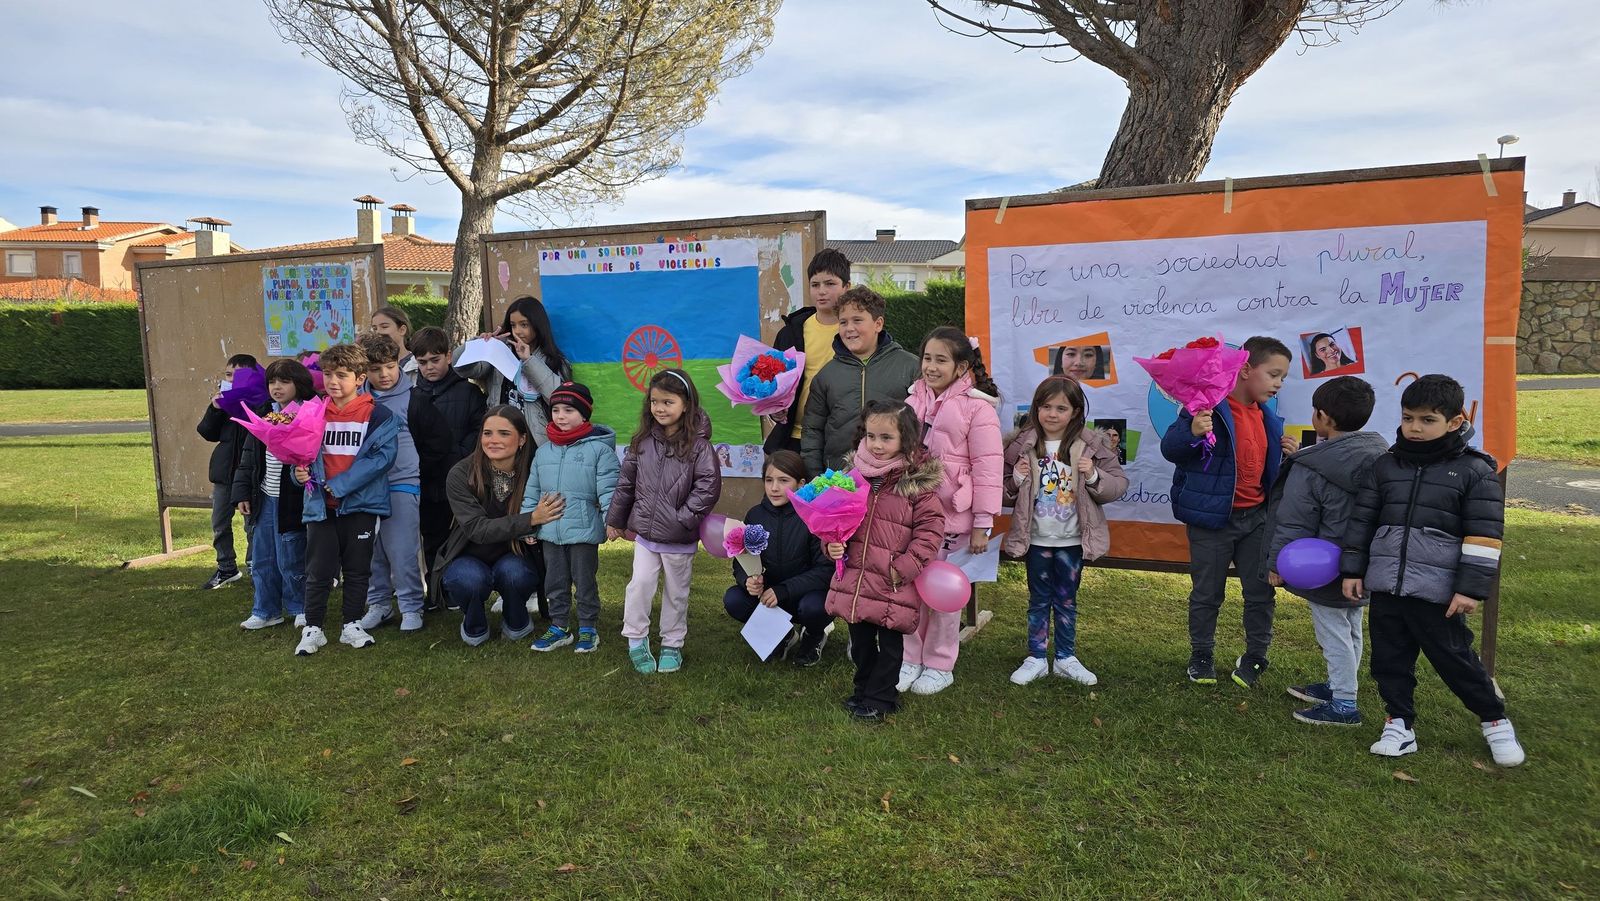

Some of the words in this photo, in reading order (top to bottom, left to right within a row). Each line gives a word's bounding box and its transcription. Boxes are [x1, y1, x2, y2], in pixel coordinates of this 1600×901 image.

[542, 251, 560, 261] POR
[567, 249, 587, 260] UNA
[598, 245, 644, 257] SOCIEDAD
[668, 242, 708, 254] PLURAL
[1010, 253, 1048, 289] Por
[1068, 261, 1129, 281] una
[1156, 243, 1286, 275] sociedad
[1316, 230, 1425, 274] plural,
[587, 262, 613, 272] LIBRE
[629, 261, 640, 271] DE
[658, 257, 721, 270] VIOLENCIAS
[1011, 295, 1063, 328] libre
[1078, 295, 1105, 321] de
[1121, 285, 1217, 316] violencia
[1236, 280, 1318, 312] contra
[1338, 277, 1369, 305] la
[322, 430, 362, 446] UMA
